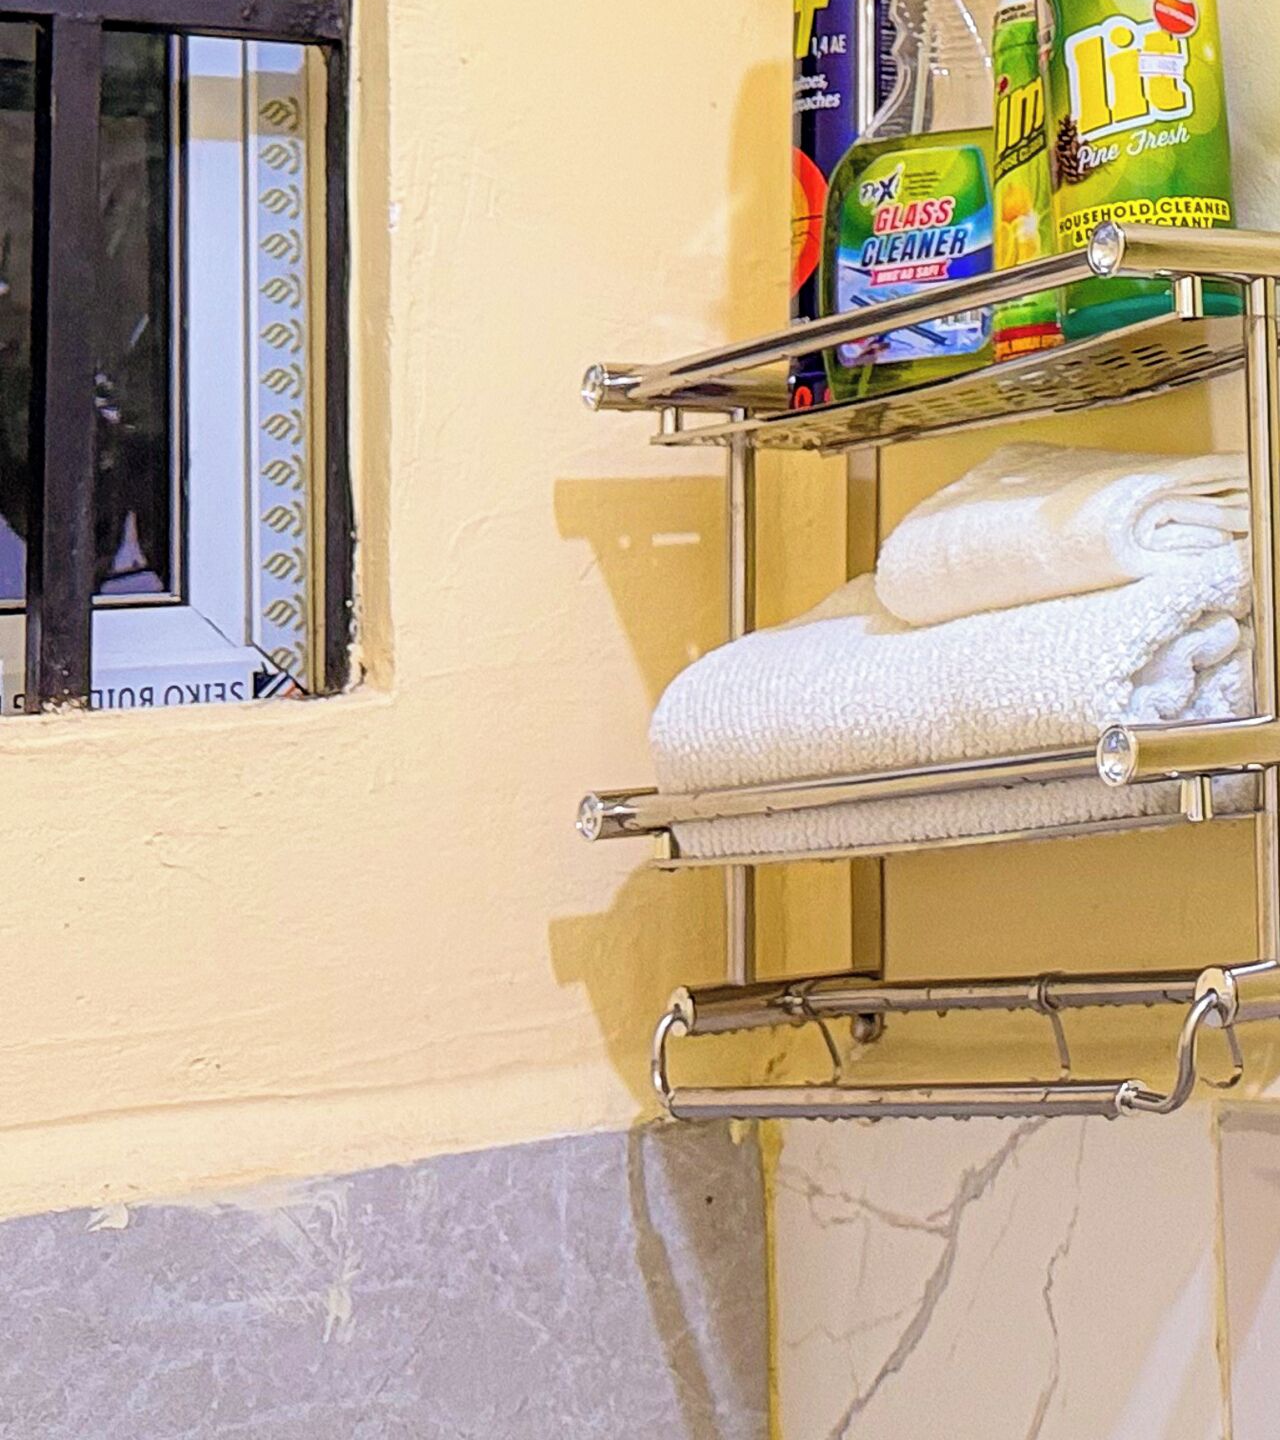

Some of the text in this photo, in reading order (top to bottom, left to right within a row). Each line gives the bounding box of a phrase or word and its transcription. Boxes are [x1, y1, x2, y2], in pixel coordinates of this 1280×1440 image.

[1077, 142, 1120, 174] Pine
[1127, 123, 1191, 156] Fresh
[875, 198, 953, 233] GLASS
[1059, 200, 1228, 233] HOUSEHOLD CLEANER
[860, 226, 970, 267] CLEANER
